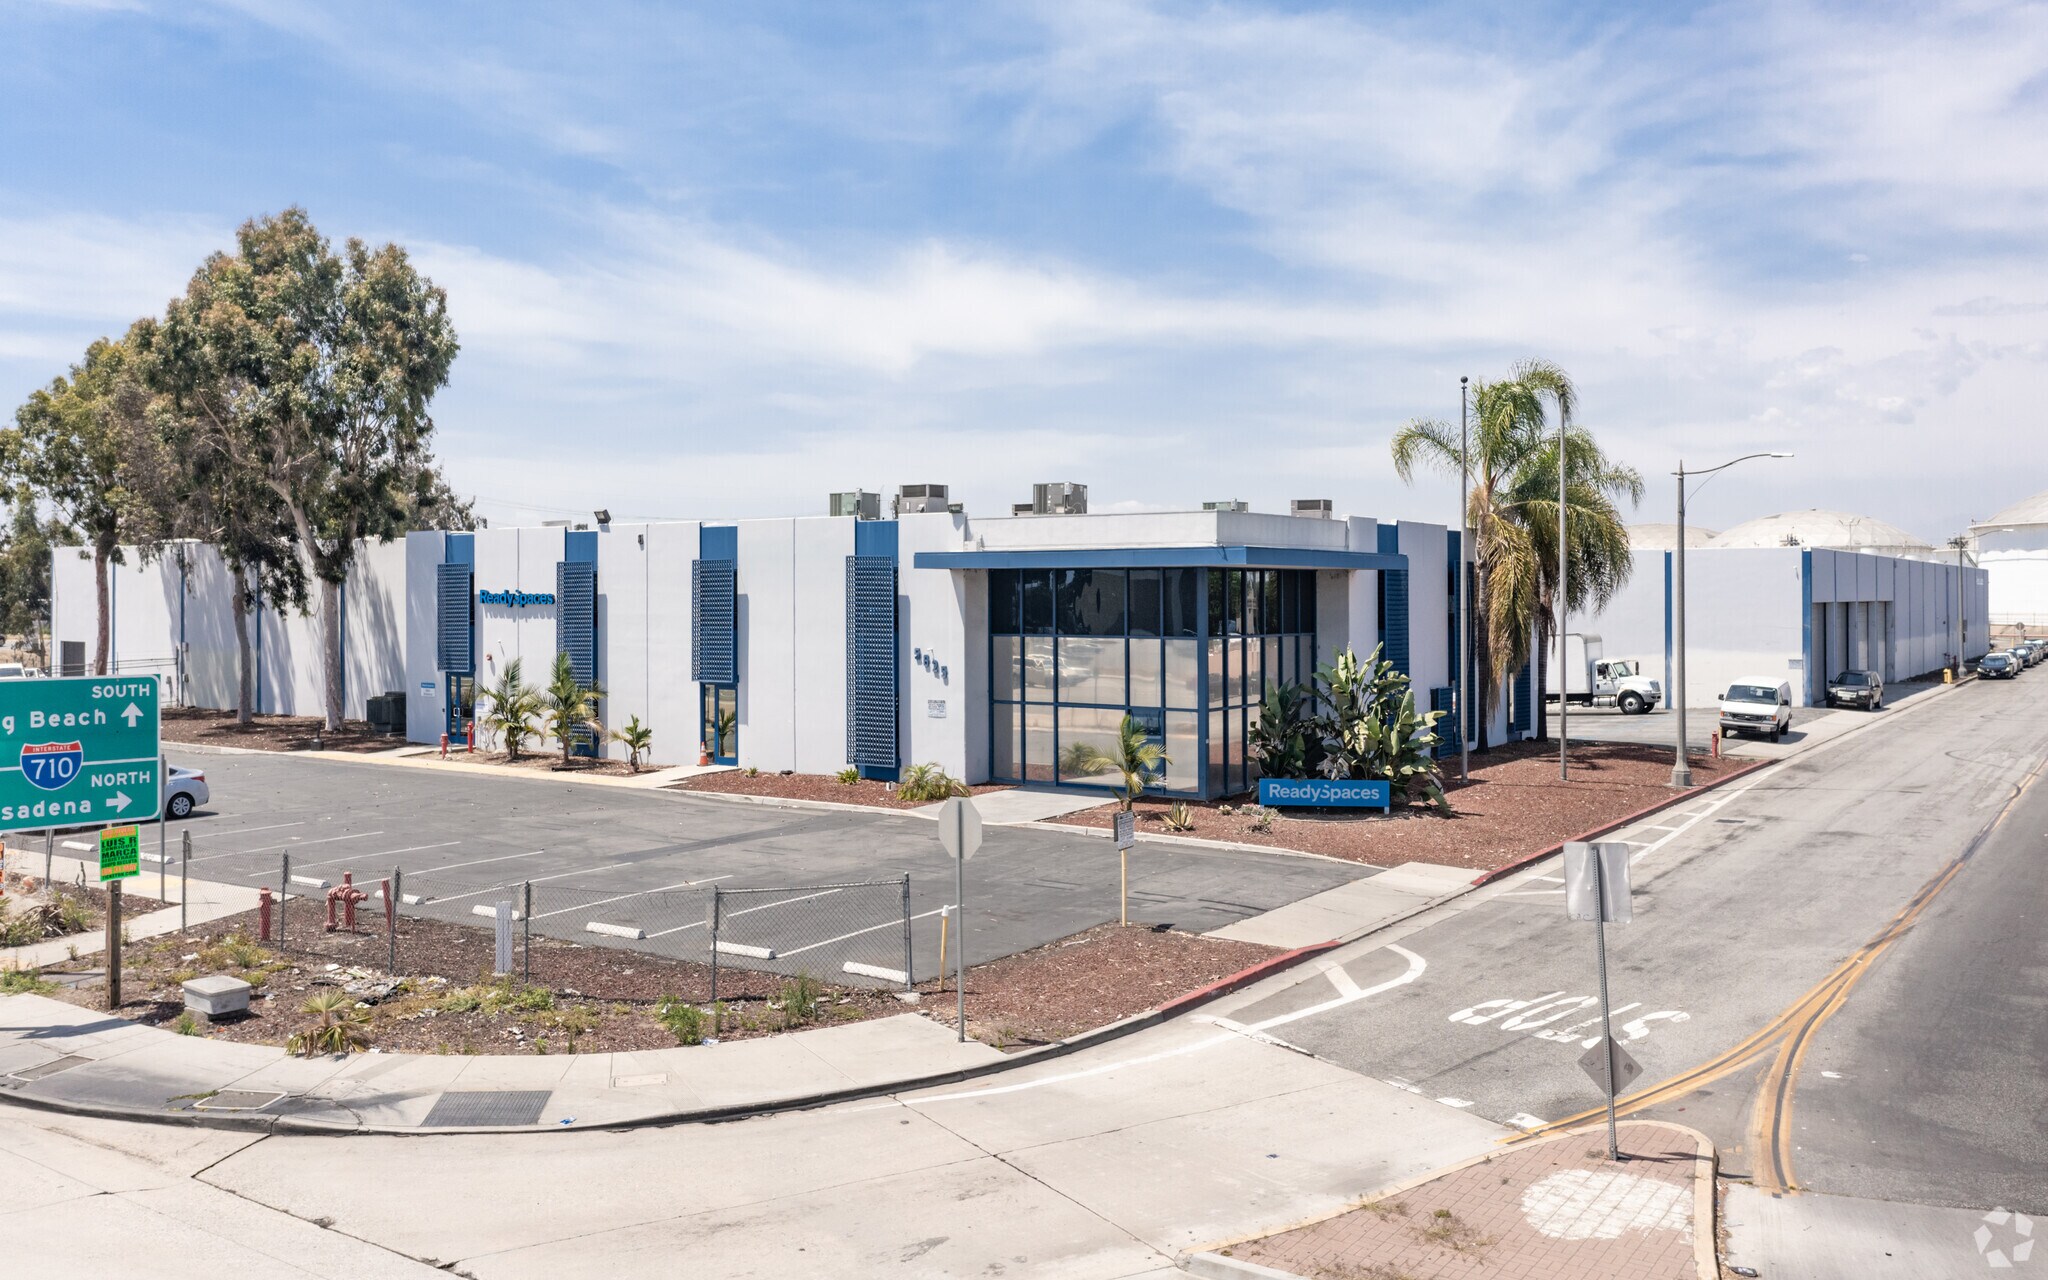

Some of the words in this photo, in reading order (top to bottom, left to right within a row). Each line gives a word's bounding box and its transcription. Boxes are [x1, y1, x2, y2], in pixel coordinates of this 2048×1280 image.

[480, 589, 555, 607] ReadySpaces
[92, 684, 150, 698] SOUTH
[30, 709, 107, 728] Beach
[31, 757, 73, 779] 710
[91, 771, 150, 787] NORTH
[1269, 783, 1380, 802] ReadySpaces
[102, 837, 125, 848] LUIS
[102, 848, 136, 859] MARCA
